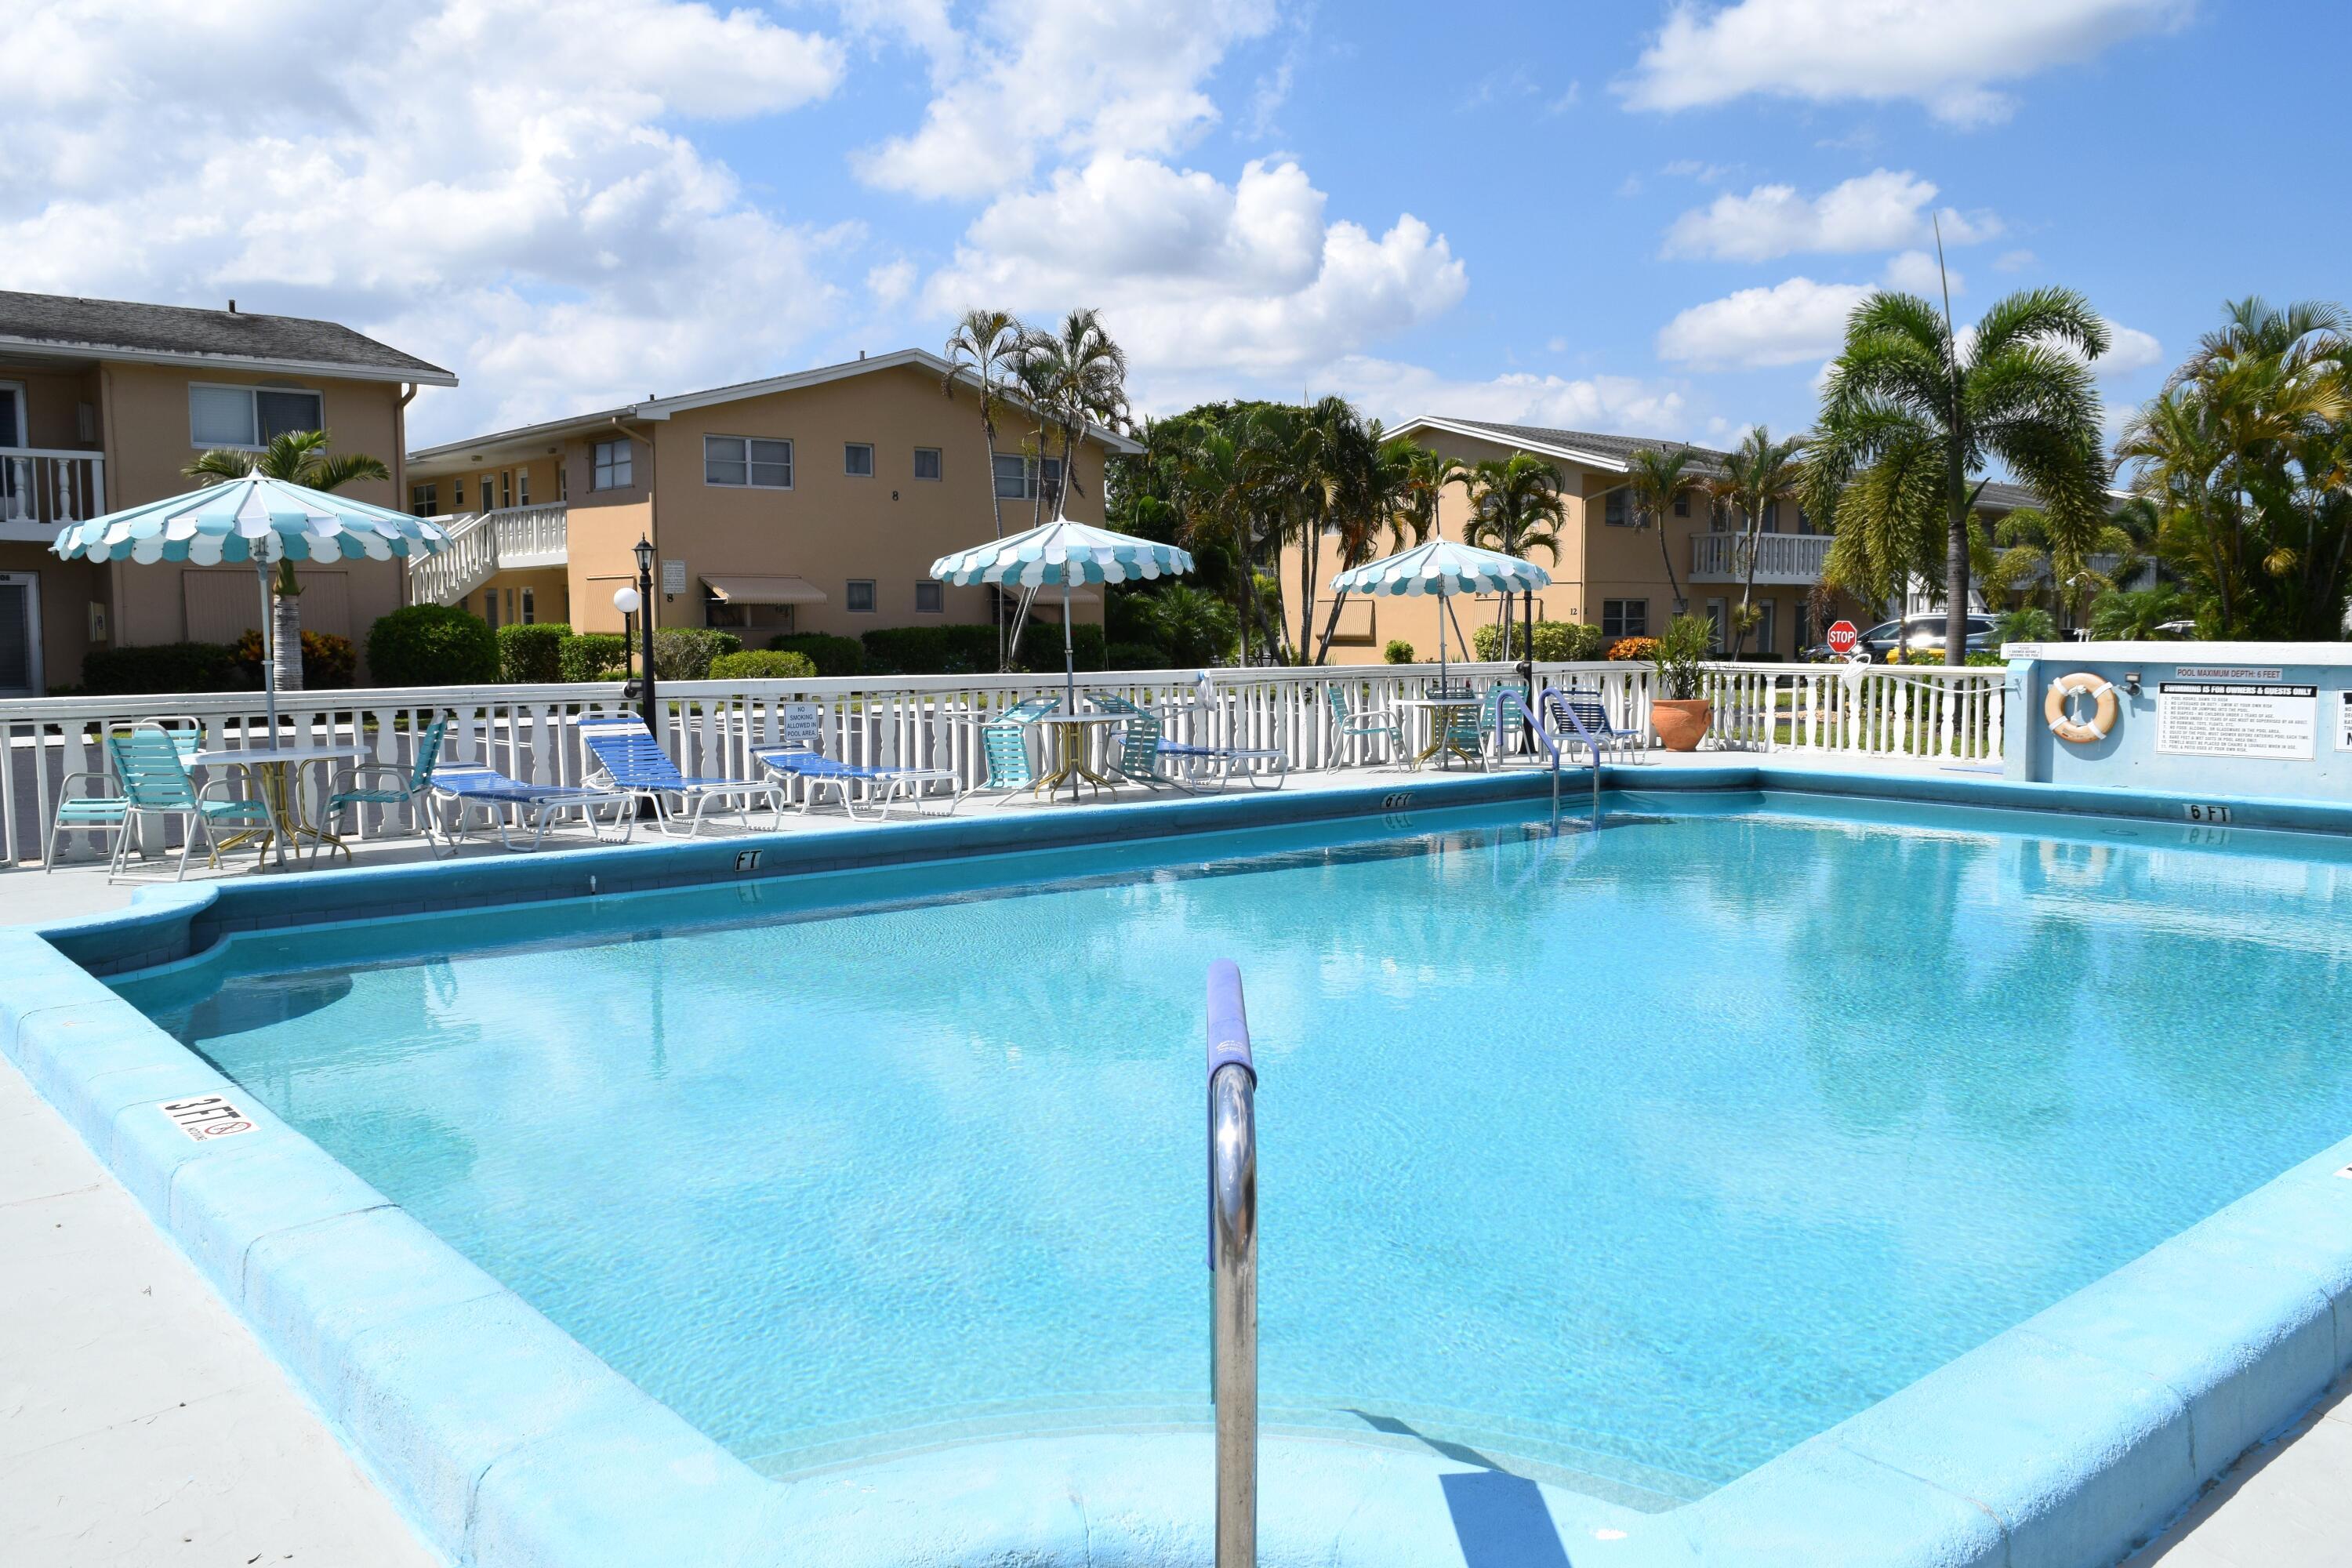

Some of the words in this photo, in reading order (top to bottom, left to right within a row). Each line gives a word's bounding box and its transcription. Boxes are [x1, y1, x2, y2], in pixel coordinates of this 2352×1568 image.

[892, 490, 898, 501] 8
[667, 593, 673, 603] 8
[1830, 631, 1855, 643] STOP
[1396, 792, 1415, 807] FT
[2191, 805, 2201, 820] 6
[2207, 806, 2228, 822] FT
[736, 850, 763, 870] FT
[165, 1098, 222, 1110] 3
[172, 1106, 241, 1125] FT
